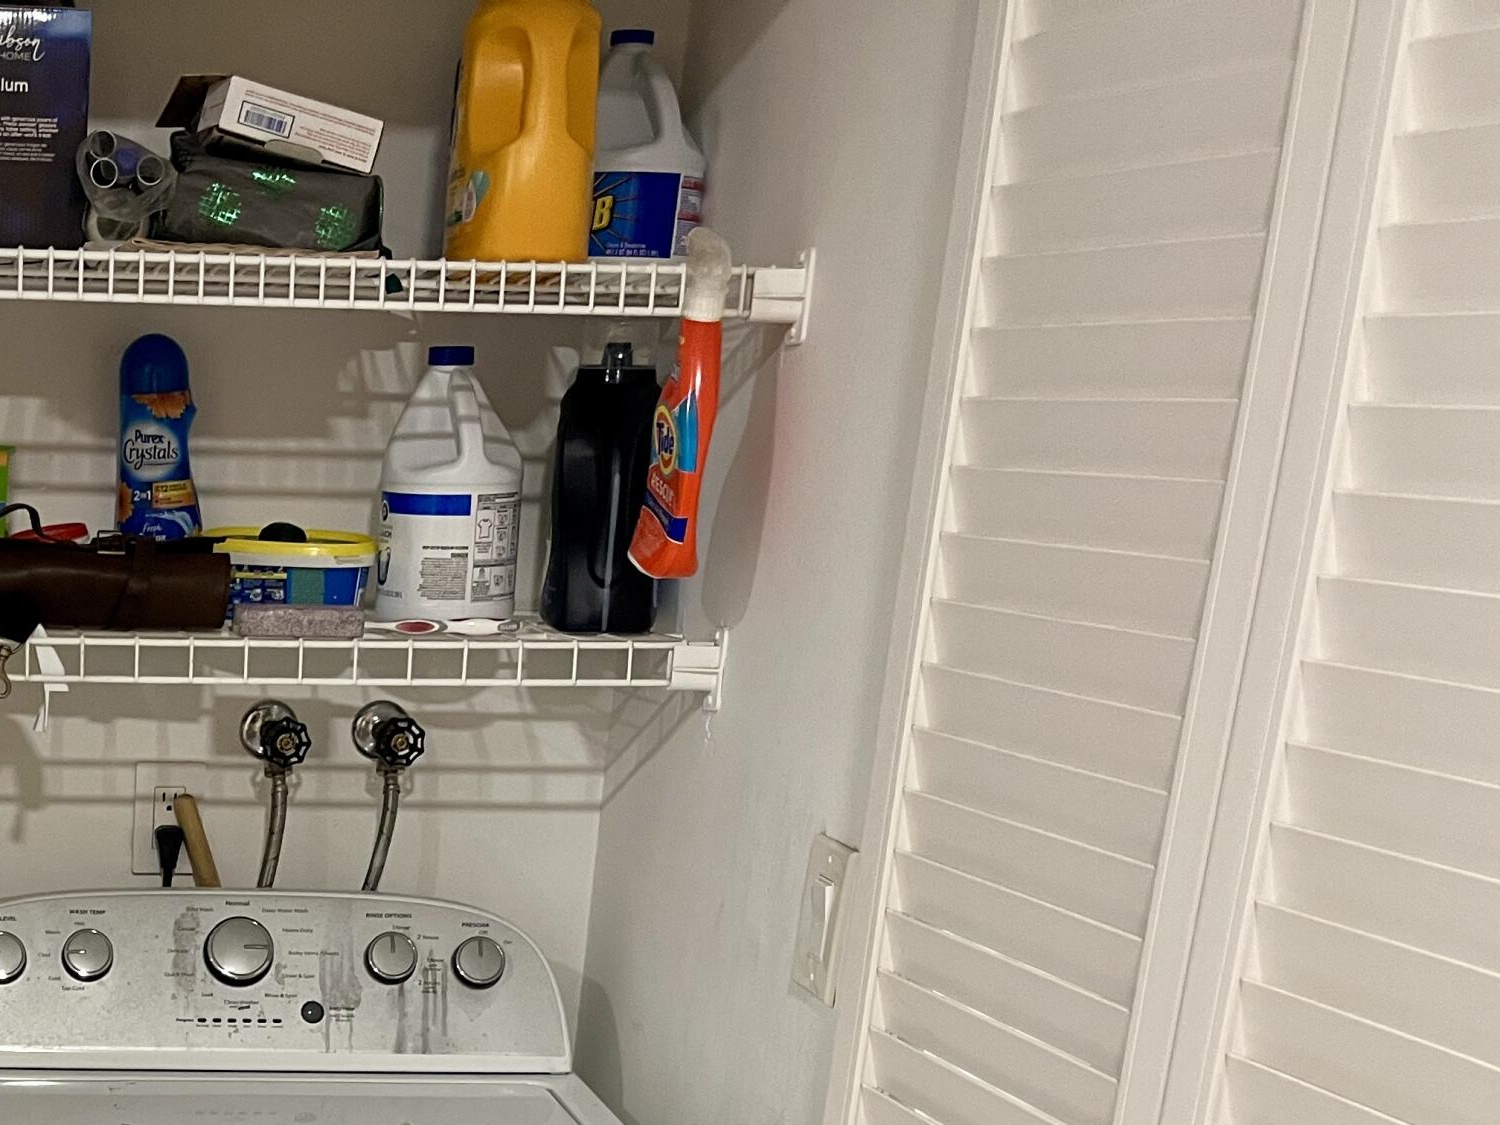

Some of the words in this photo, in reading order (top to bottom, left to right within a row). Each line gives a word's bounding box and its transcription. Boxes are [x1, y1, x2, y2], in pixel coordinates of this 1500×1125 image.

[135, 429, 165, 444] Purex
[656, 422, 675, 455] Tide
[123, 438, 179, 470] Crystals
